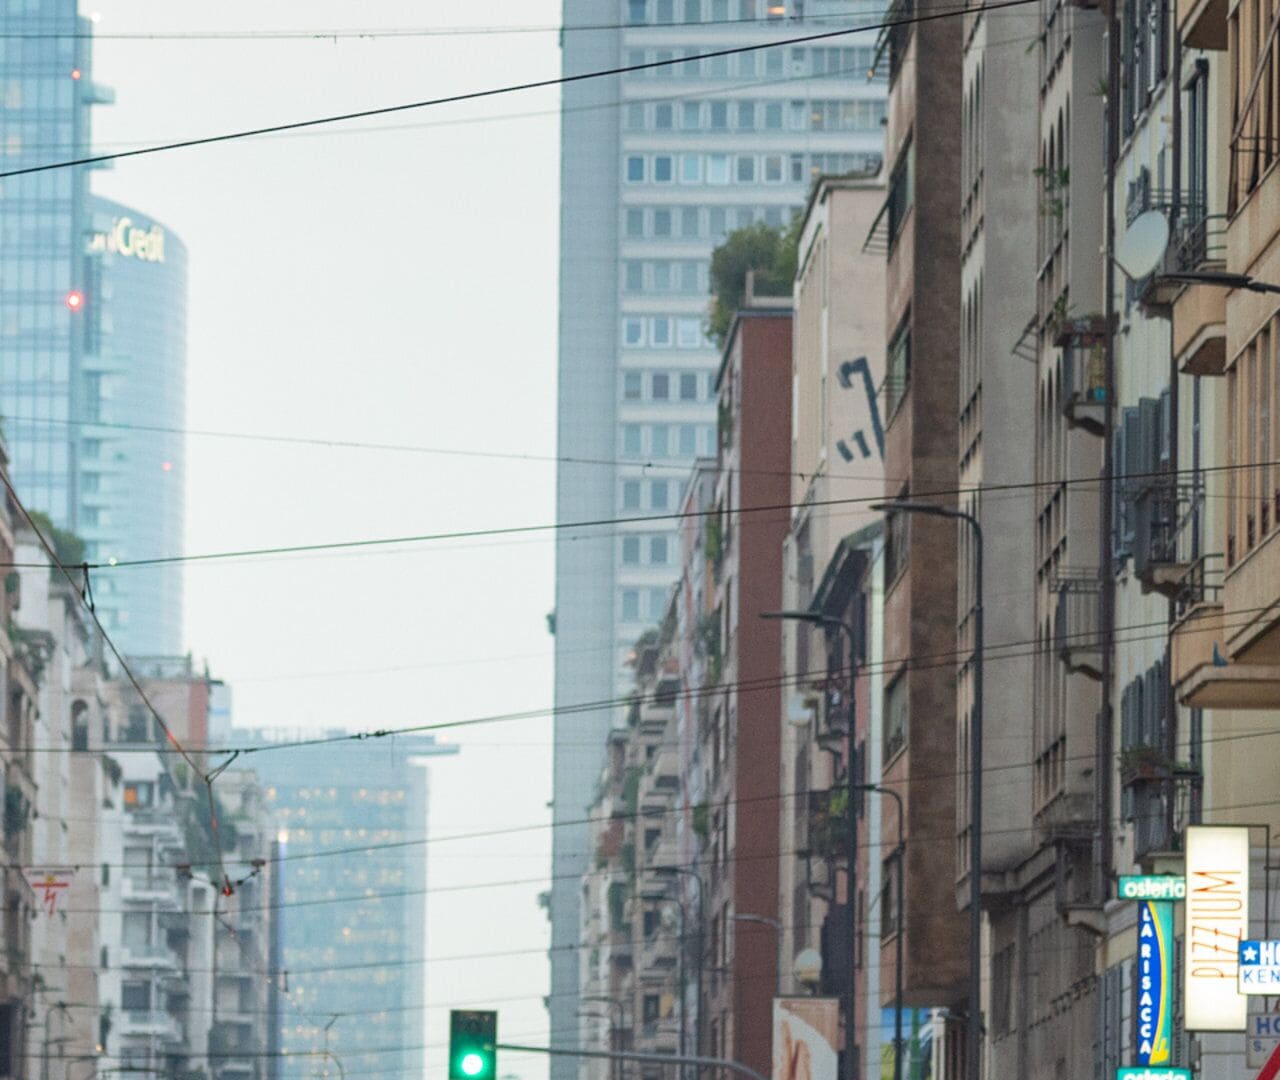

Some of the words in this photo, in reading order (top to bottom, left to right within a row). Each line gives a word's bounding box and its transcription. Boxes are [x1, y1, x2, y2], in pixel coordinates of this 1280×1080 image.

[1140, 907, 1153, 938] LA
[1192, 871, 1242, 978] PIZZIUM
[1140, 943, 1153, 1054] RISACCA
